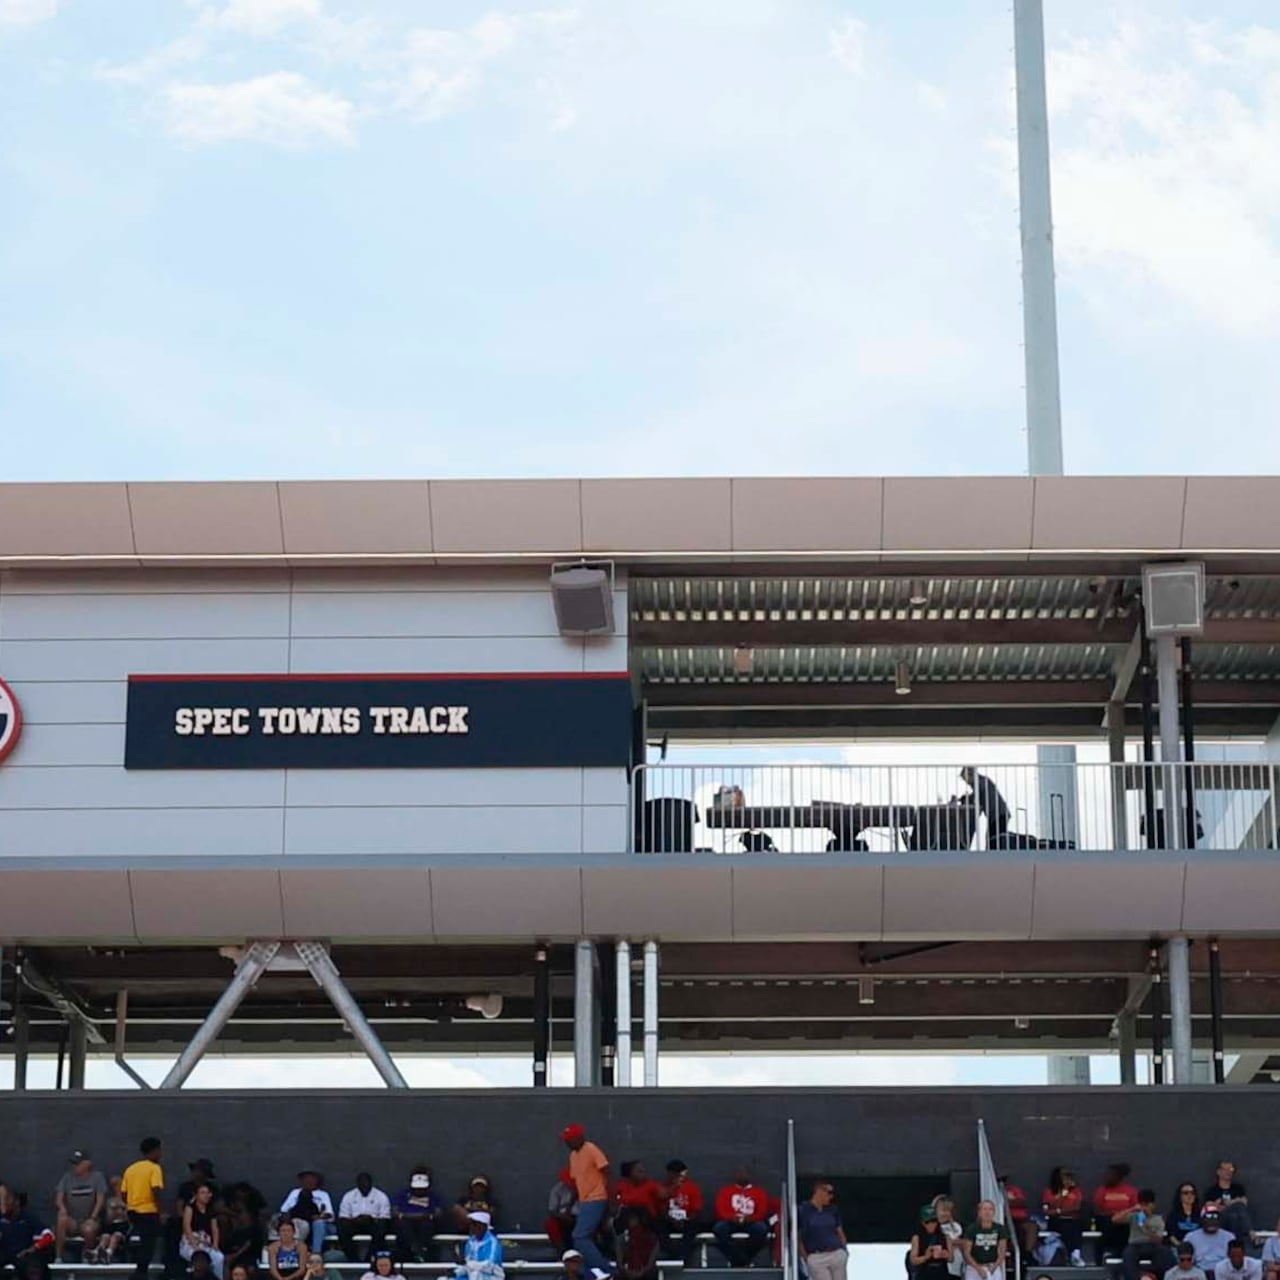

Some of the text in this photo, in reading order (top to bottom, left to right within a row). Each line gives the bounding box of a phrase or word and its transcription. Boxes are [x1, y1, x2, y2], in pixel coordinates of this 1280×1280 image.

[175, 706, 469, 735] SPEC TOWNS TRACK
